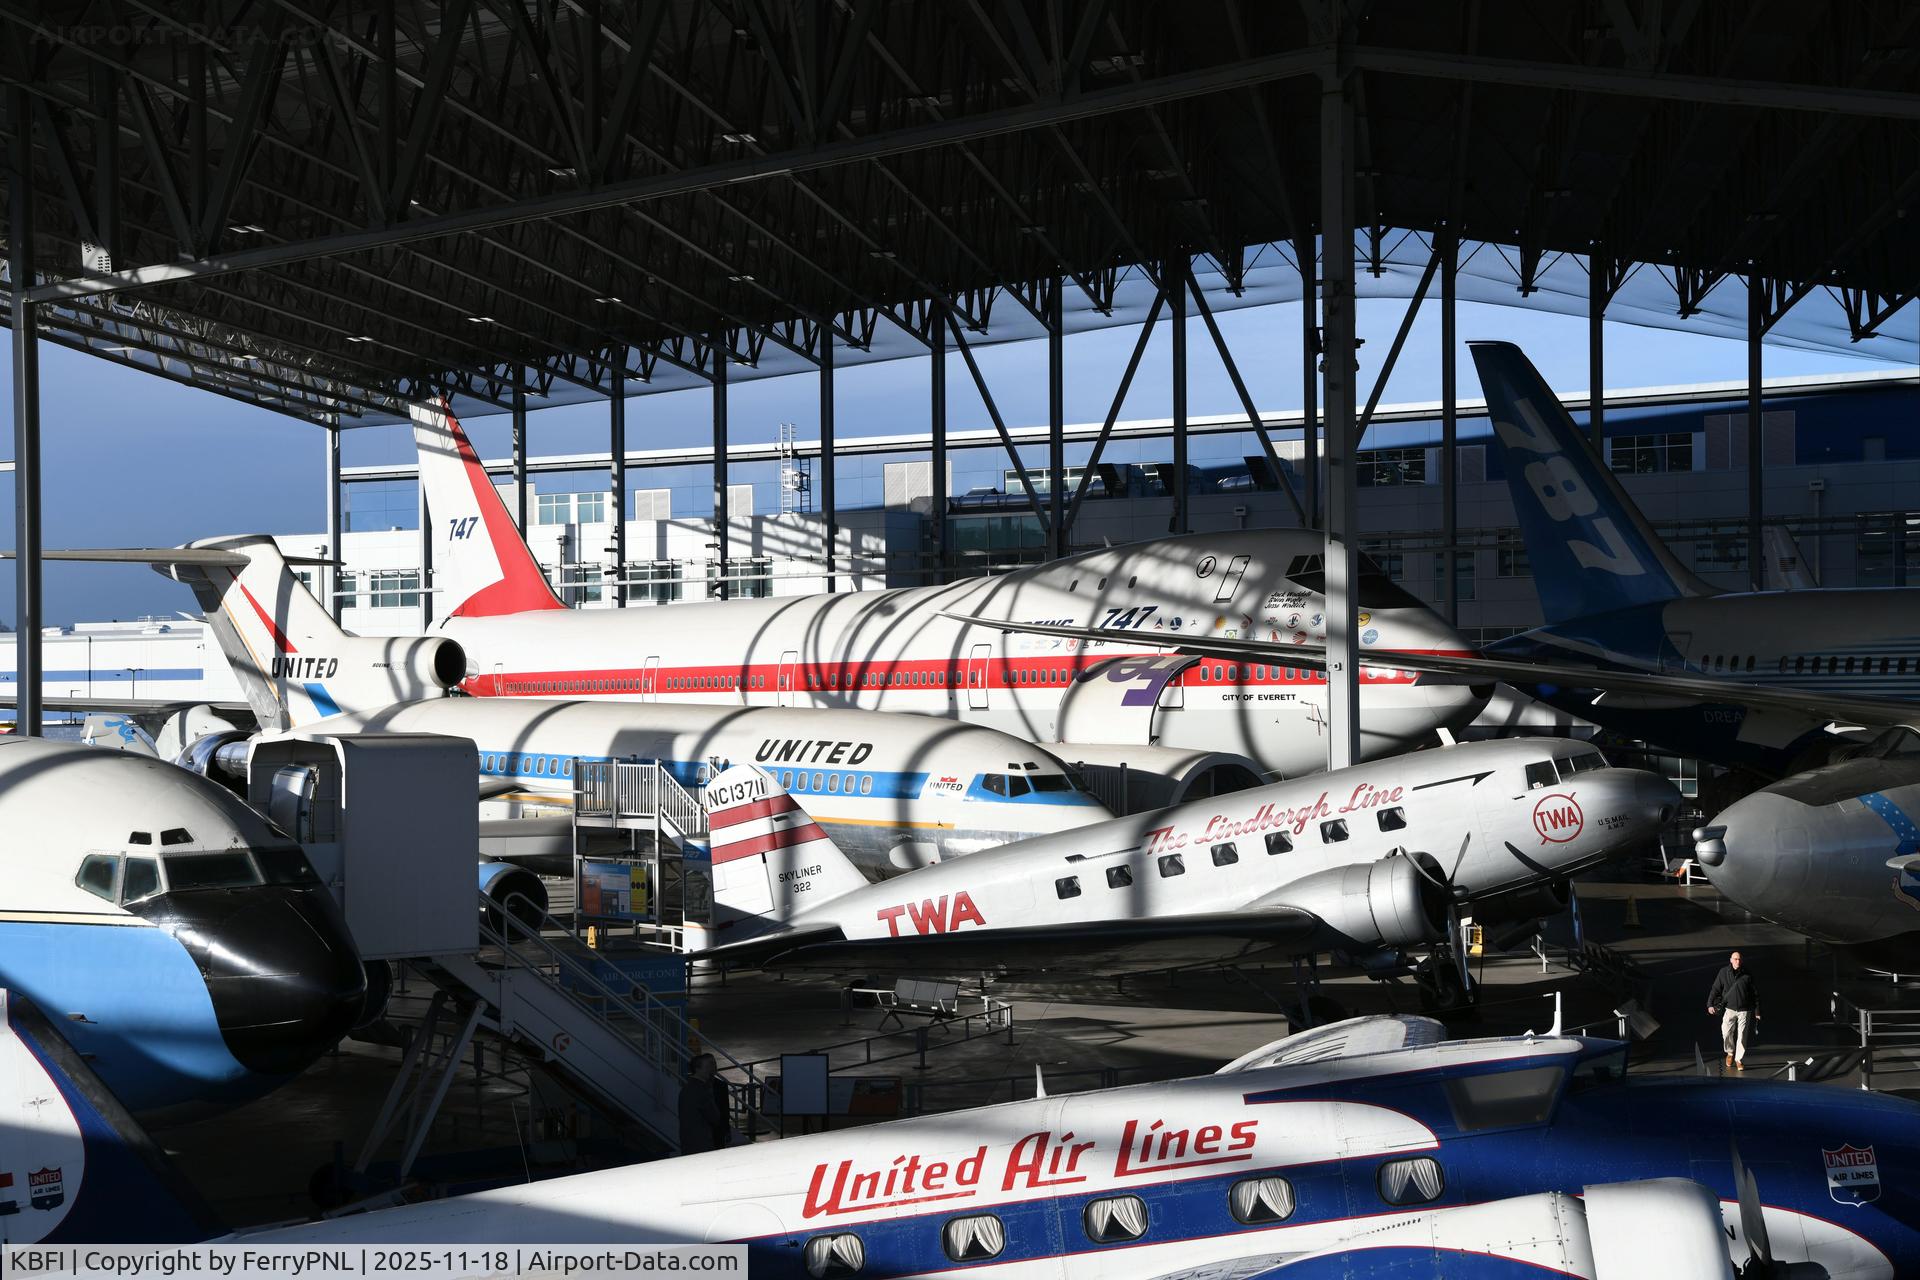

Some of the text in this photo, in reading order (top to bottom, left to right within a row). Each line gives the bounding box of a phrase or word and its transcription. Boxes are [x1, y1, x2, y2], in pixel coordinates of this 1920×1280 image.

[449, 517, 479, 541] 747
[1098, 605, 1159, 631] 747
[271, 657, 339, 680] UNITED
[1257, 693, 1297, 701] EVERETT
[755, 739, 874, 765] UNITED
[707, 777, 766, 808] NC13711
[929, 782, 963, 791] UNITED
[1144, 783, 1404, 856] The Lindbergh Line
[1536, 806, 1580, 832] TWA
[778, 864, 823, 883] SKYLINER
[793, 881, 812, 893] 322
[876, 890, 987, 938] TWA
[802, 1119, 1259, 1219] United Air Lines
[1826, 1151, 1873, 1167] UNITED
[30, 1171, 61, 1186] UNITED
[1833, 1171, 1875, 1182] AIR LINES
[33, 1185, 61, 1195] AIR LINES
